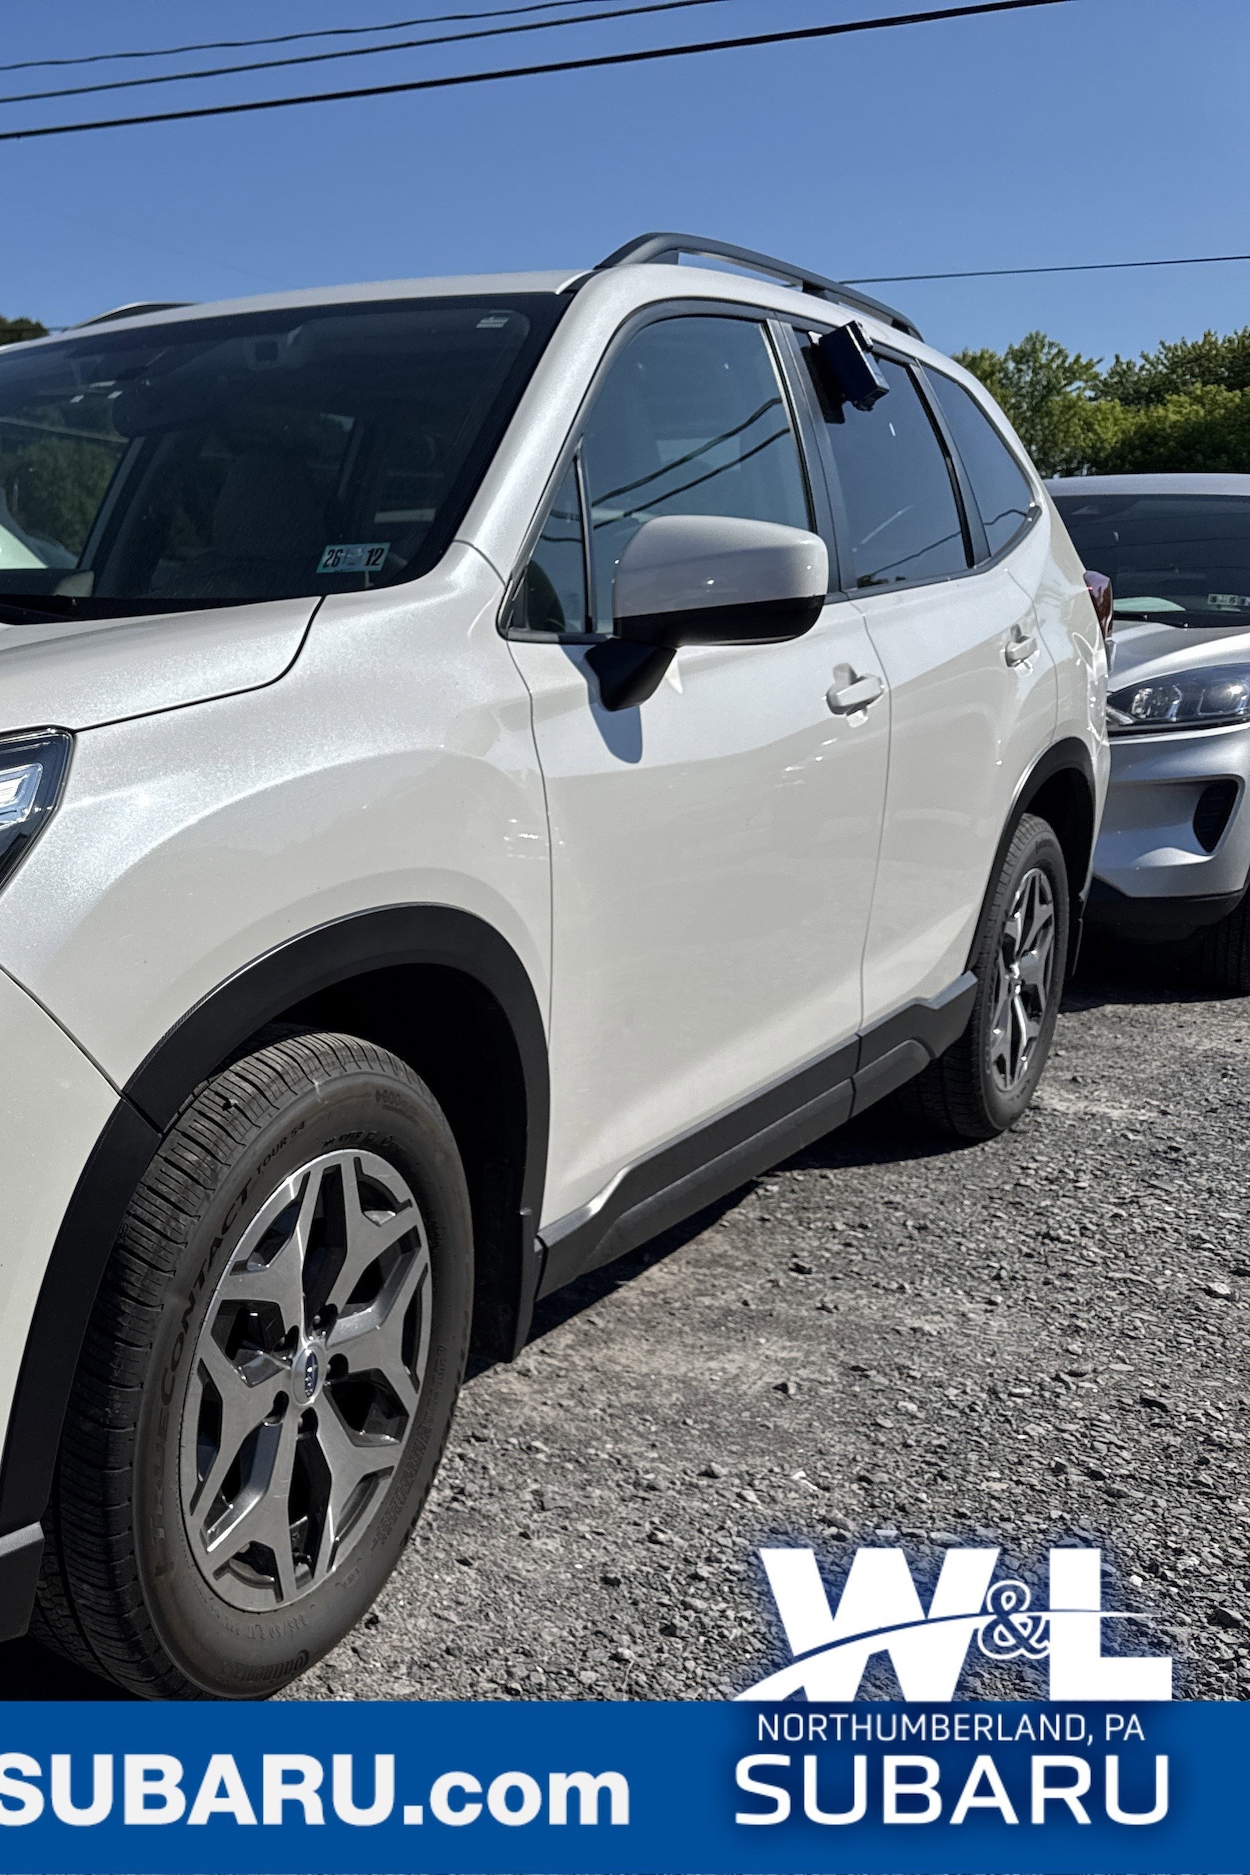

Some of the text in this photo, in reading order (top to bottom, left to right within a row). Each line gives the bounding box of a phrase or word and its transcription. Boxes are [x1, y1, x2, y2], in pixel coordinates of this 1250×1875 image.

[323, 547, 385, 569] 26 12
[255, 1136, 288, 1175] TOUR
